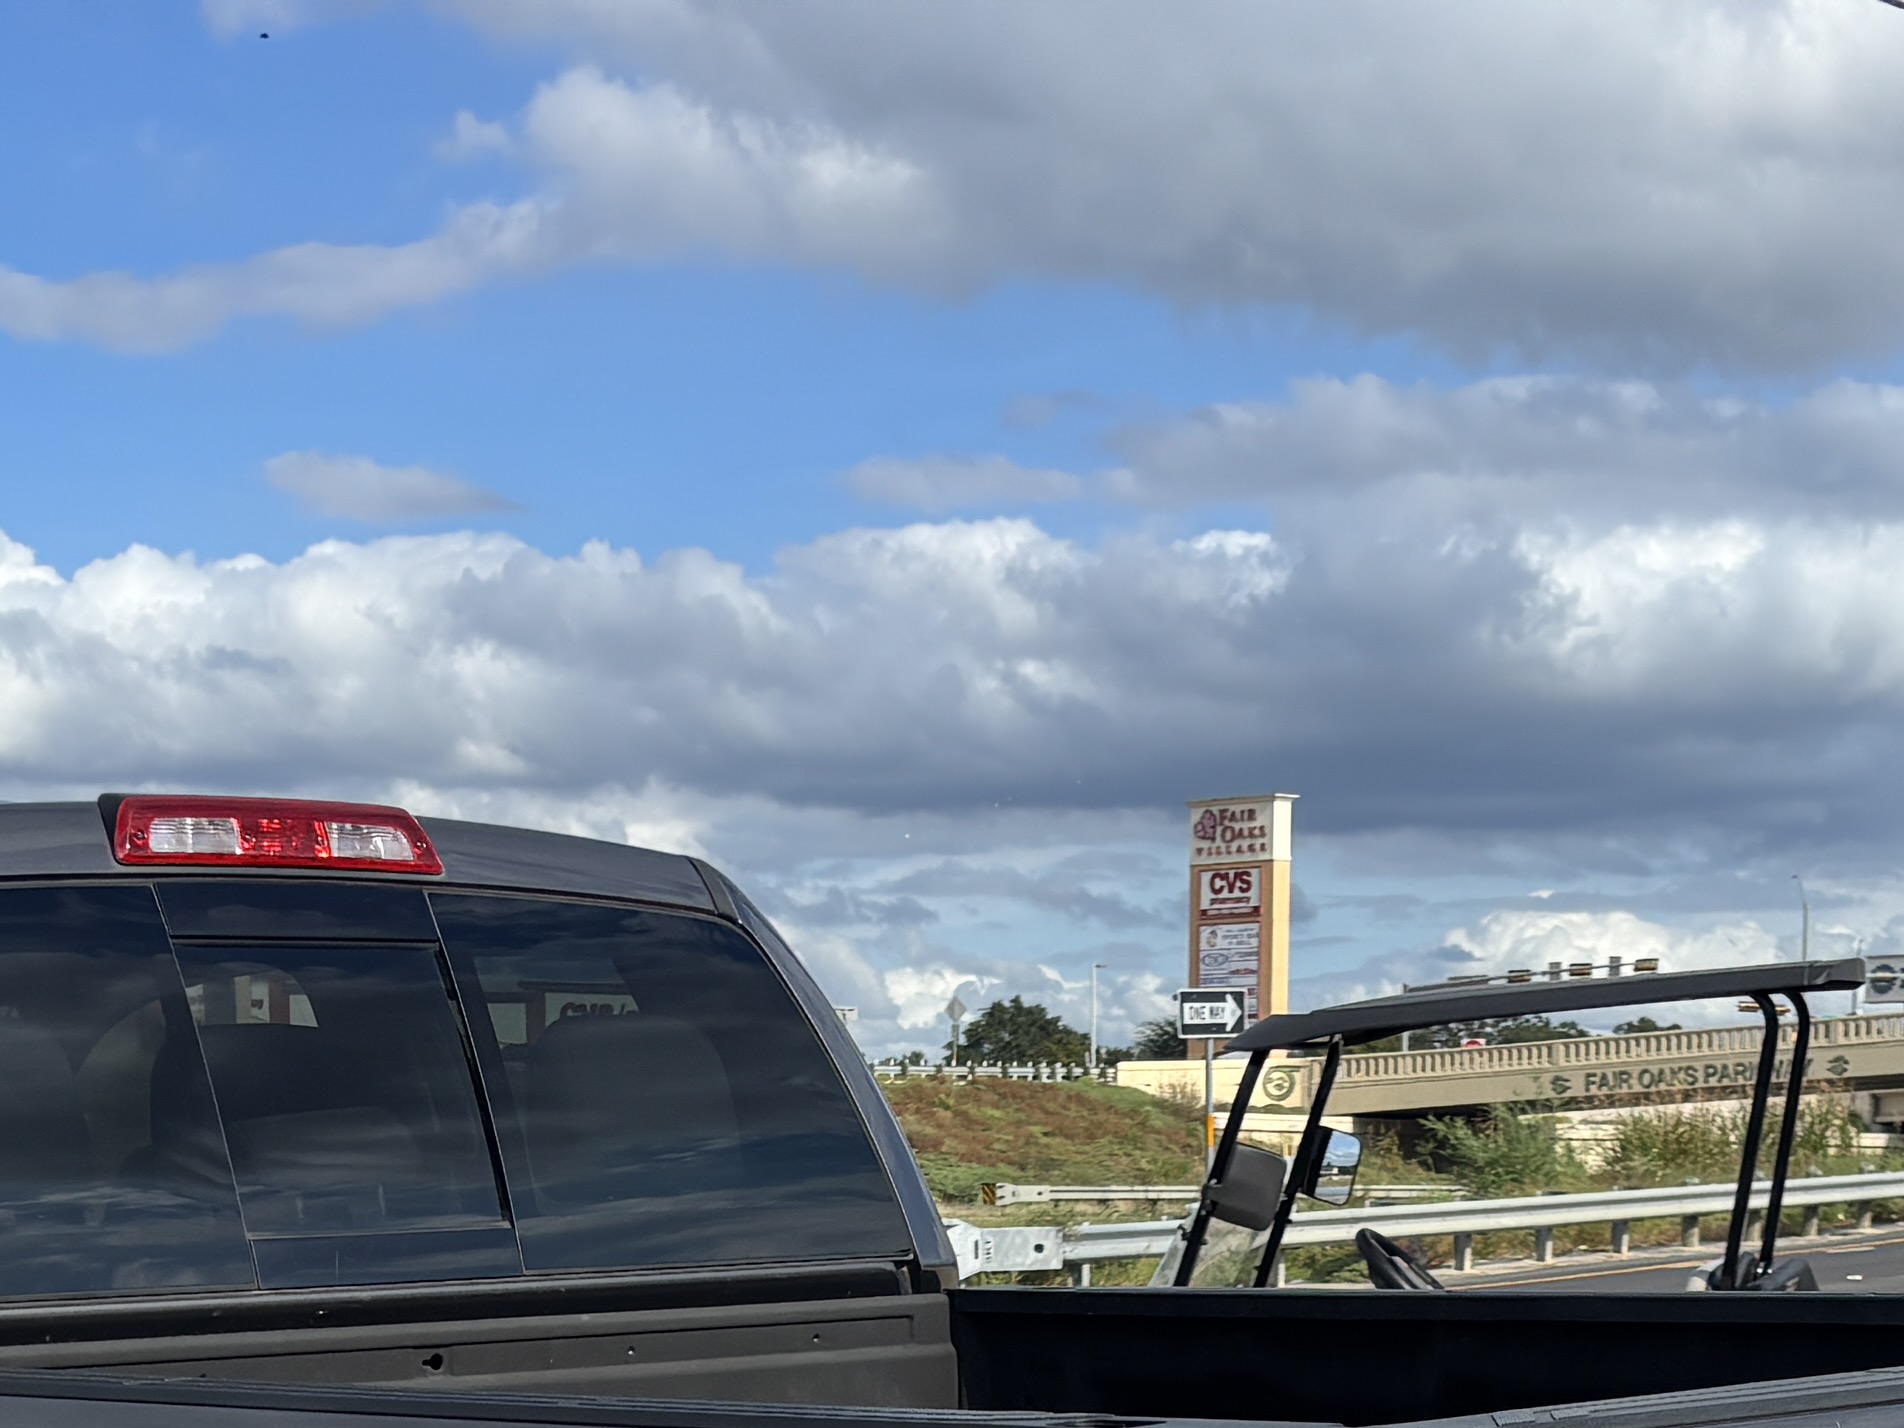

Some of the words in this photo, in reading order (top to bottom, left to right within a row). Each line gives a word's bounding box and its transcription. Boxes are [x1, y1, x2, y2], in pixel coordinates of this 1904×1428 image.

[1217, 808, 1257, 826] FAIR
[1220, 825, 1267, 843] OAKS
[1209, 870, 1252, 895] CVS
[1585, 1070, 1633, 1093] FAIR
[1637, 1066, 1696, 1089] OAKS
[1703, 1058, 1813, 1084] PARY
